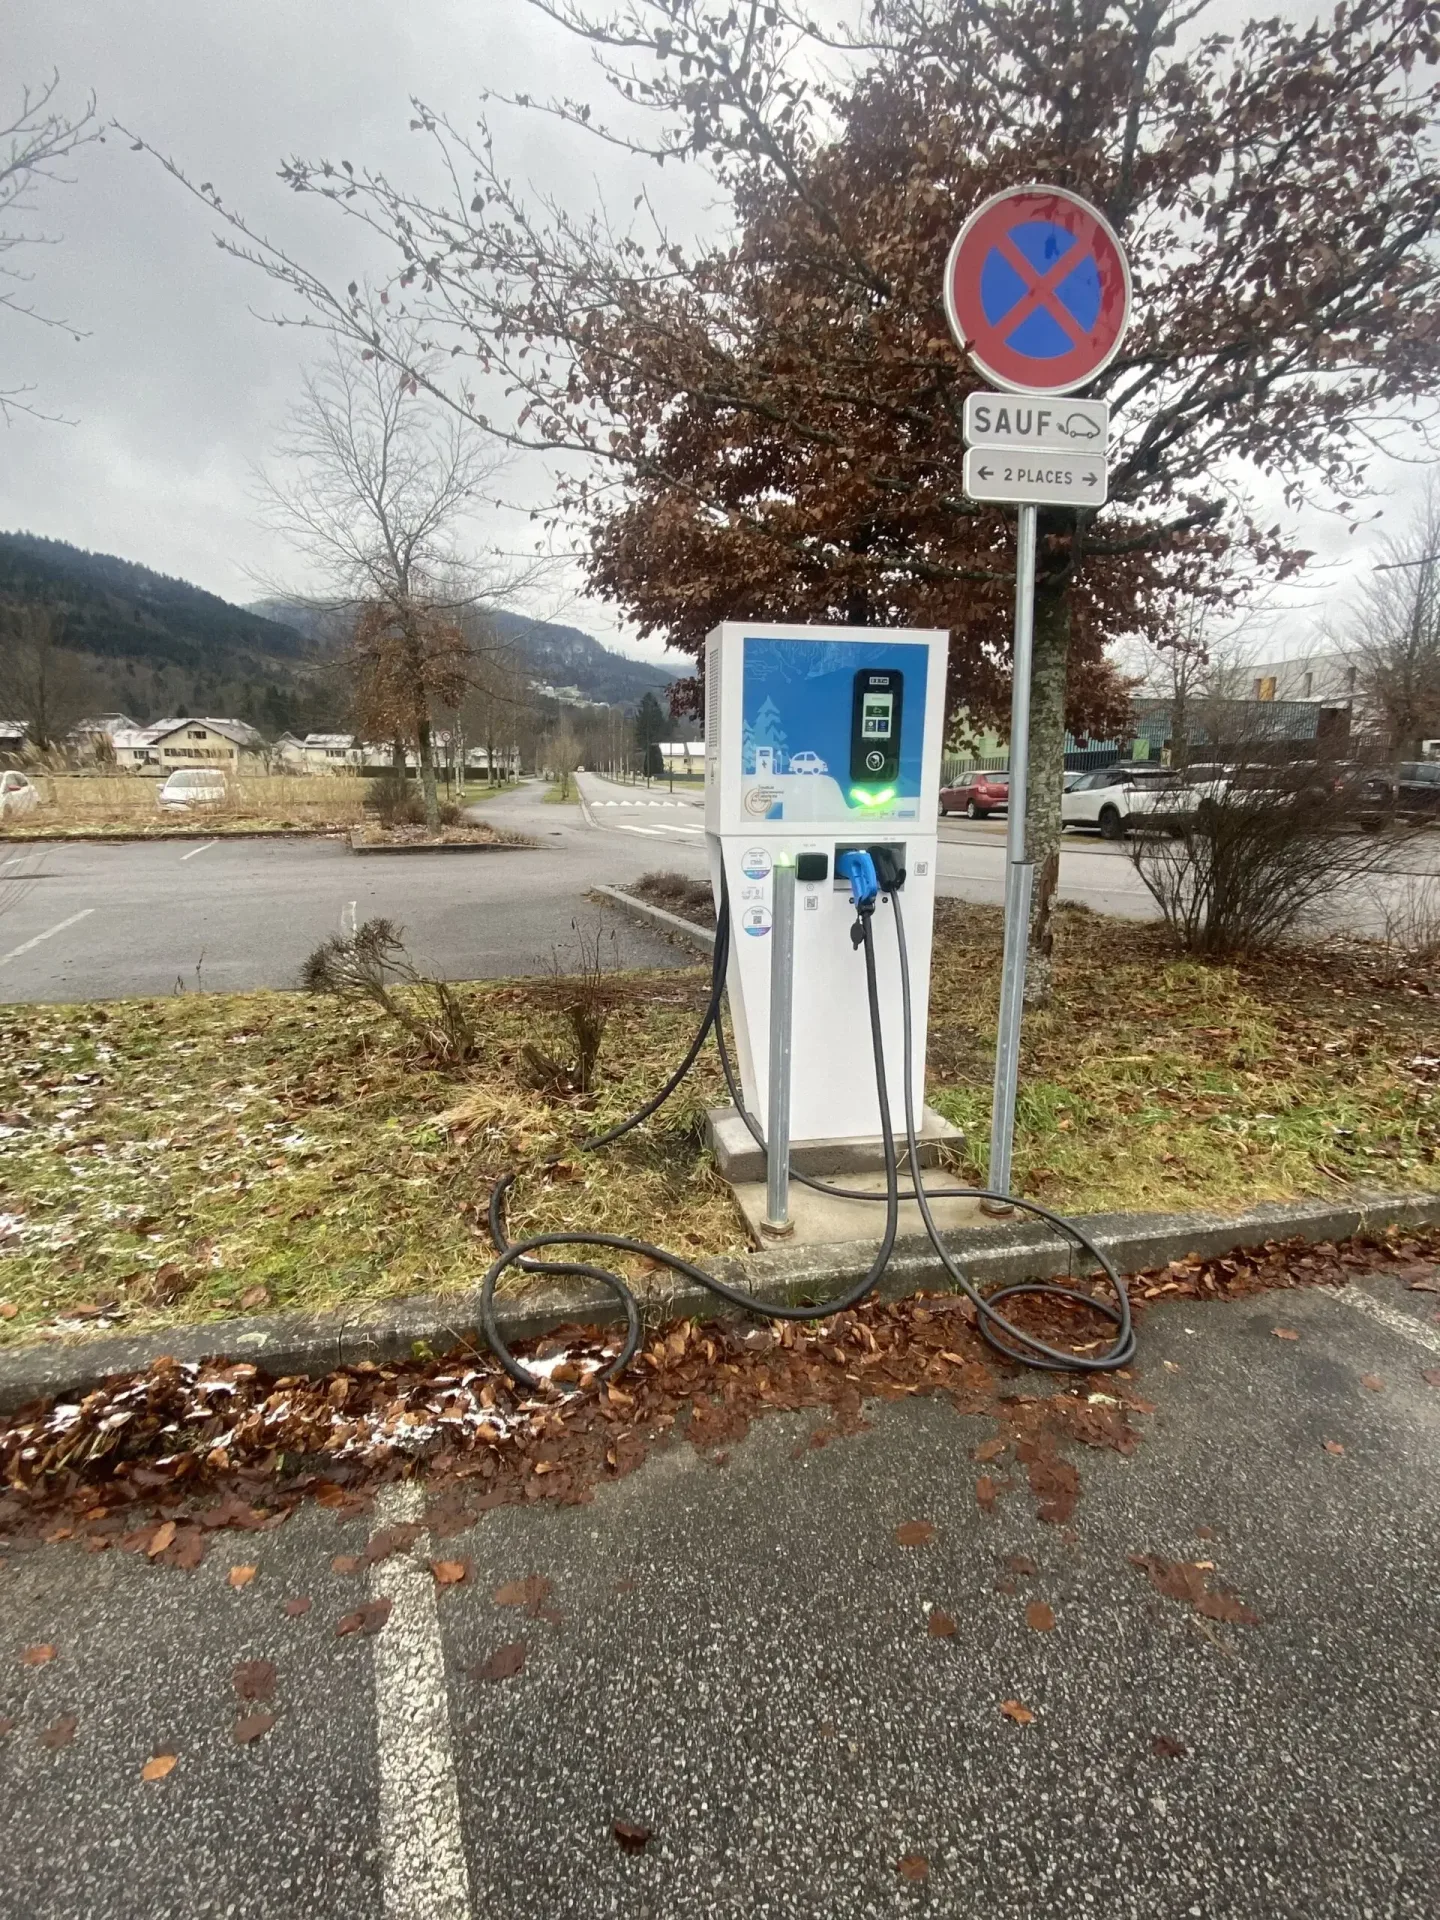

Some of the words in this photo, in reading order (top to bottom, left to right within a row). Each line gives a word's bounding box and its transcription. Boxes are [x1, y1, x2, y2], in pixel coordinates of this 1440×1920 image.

[974, 406, 1052, 436] SAUF
[1004, 468, 1013, 481] 2
[1017, 469, 1073, 484] PLACES
